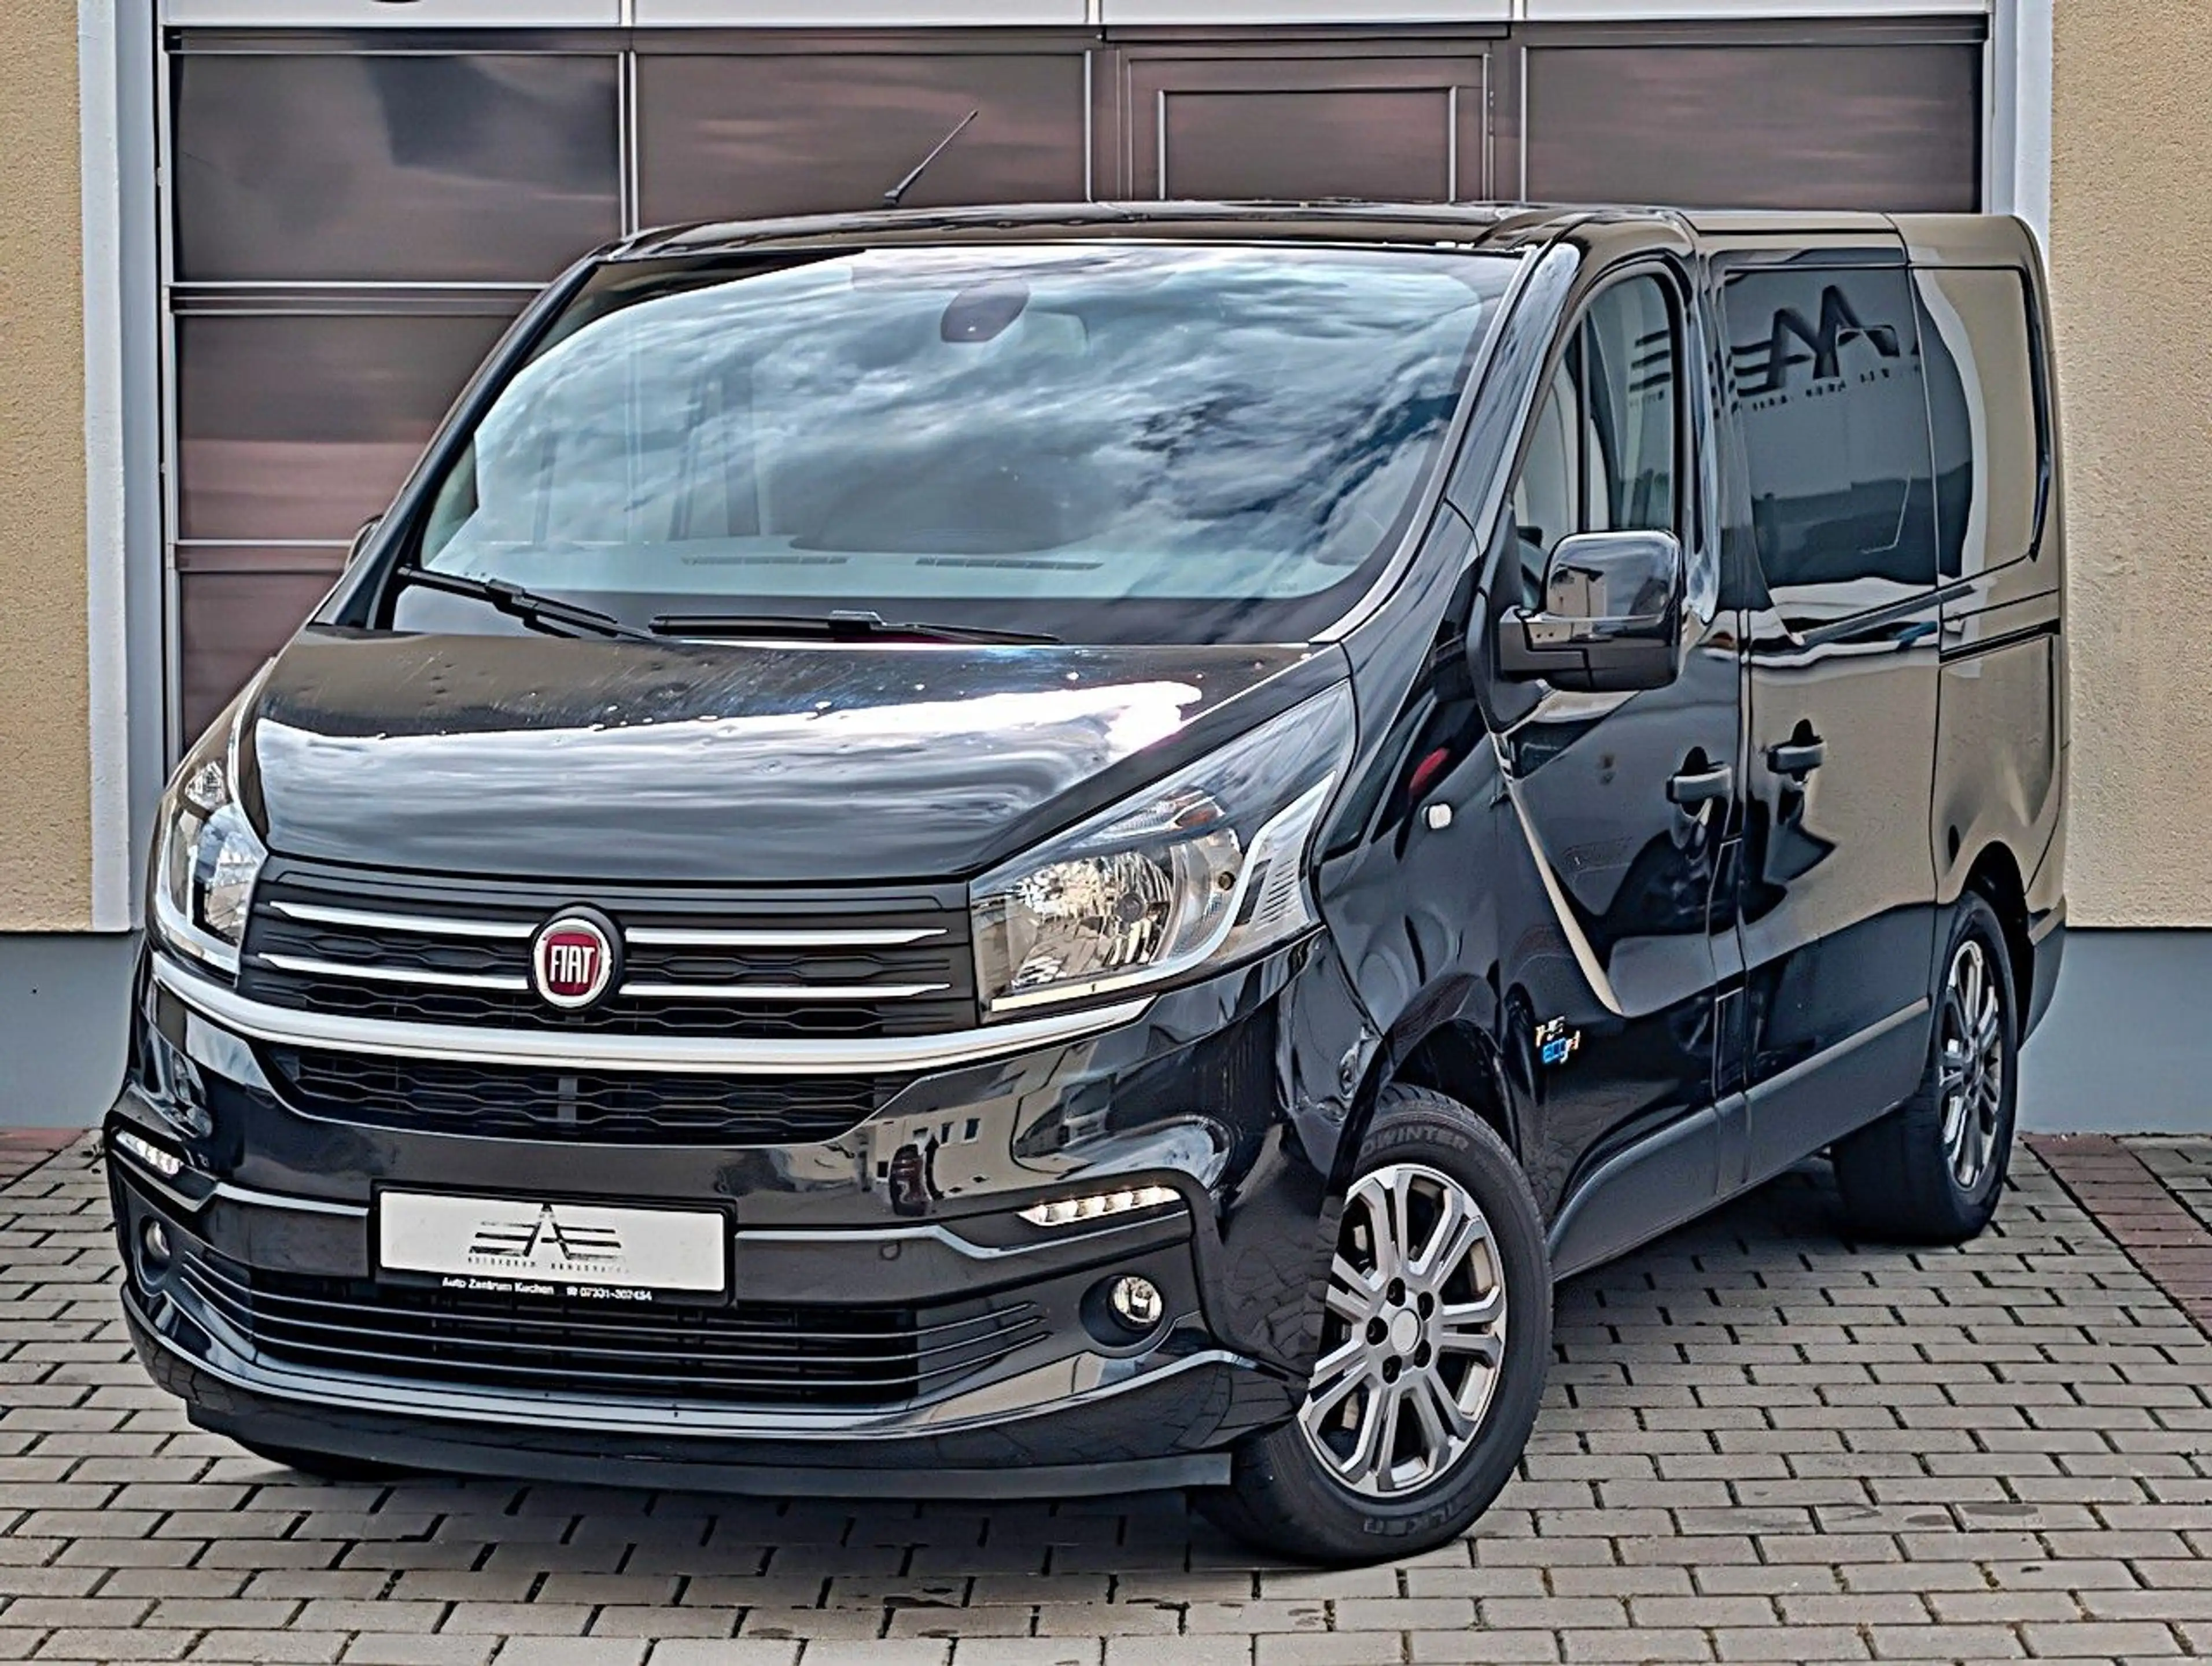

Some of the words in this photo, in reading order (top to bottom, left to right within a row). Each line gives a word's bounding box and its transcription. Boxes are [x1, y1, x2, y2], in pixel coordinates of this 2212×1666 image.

[550, 945, 595, 984] FIAT
[442, 1277, 467, 1289] Auto
[468, 1278, 512, 1292] Zentrum
